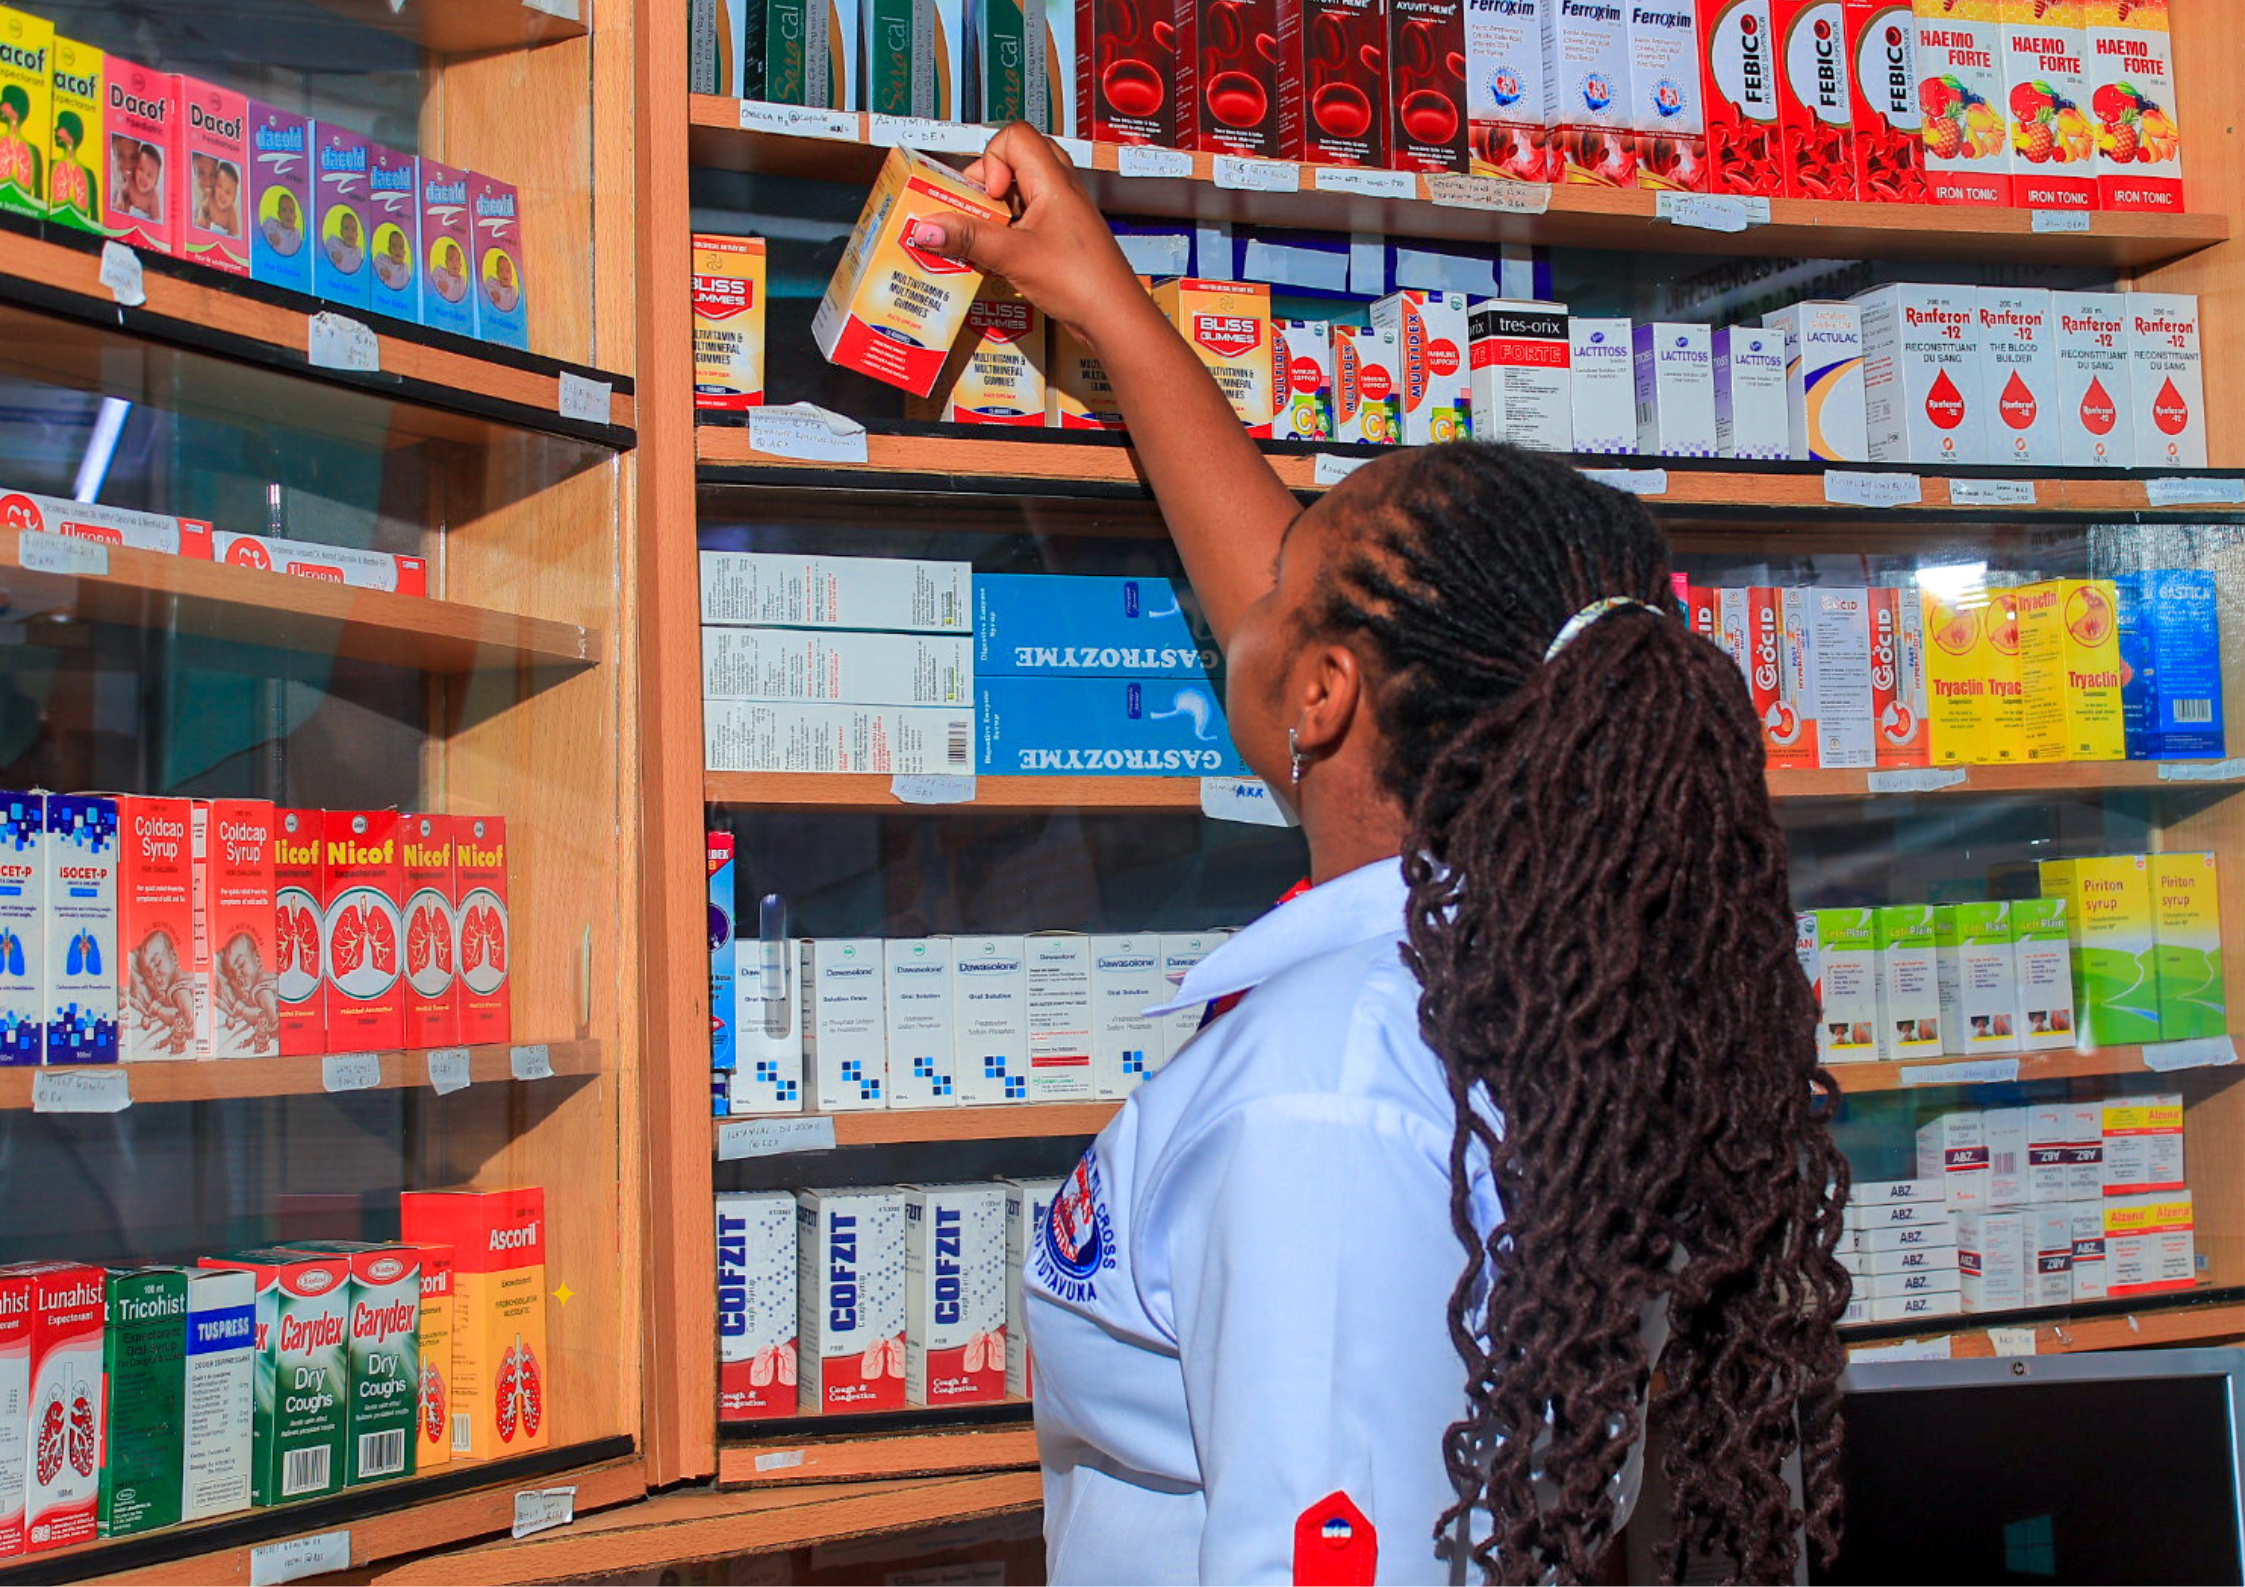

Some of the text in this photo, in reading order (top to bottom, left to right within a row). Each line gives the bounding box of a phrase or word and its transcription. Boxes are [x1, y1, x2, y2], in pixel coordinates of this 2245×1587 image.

[1469, 0, 1534, 16] Ferroxim
[1561, 0, 1621, 22] Ferroxim
[1632, 7, 1692, 28] Ferroxim
[1920, 30, 1974, 49] HAEMO
[2012, 36, 2065, 55] HAEMO
[2096, 38, 2148, 57] HAEMO
[1740, 14, 1763, 103] FEBICO
[1813, 18, 1837, 107] FEBICO
[1948, 50, 1991, 68] FORTE
[2039, 55, 2081, 74] FORTE
[2124, 57, 2164, 76] FORTE
[1885, 25, 1908, 113] FEBICO
[110, 84, 165, 122] Dacof
[190, 103, 242, 140] Dacof
[256, 125, 303, 150] dacold
[321, 146, 367, 170] dacold
[370, 166, 412, 189] dacold
[426, 181, 466, 204] dacold
[1936, 187, 1998, 201] IRON TONIC
[2028, 190, 2088, 204] IRON TONIC
[2114, 190, 2173, 204] IRON TONIC
[477, 194, 515, 216] dacold
[891, 270, 950, 302] MULTIVITAMIN &
[888, 283, 942, 312] MULTIMINERAL
[893, 297, 929, 319] GUMMIES
[971, 303, 1027, 318] BLISS
[1906, 307, 1971, 327] Ranferon
[970, 318, 1027, 330] GUMMIES
[1200, 317, 1254, 332] BLISS
[1500, 318, 1560, 334] tres-orix
[1980, 309, 2042, 328] Ranferon
[2061, 316, 2121, 334] Ranferon
[2135, 317, 2193, 335] Ranferon
[1200, 332, 1255, 344] GUMMIES
[1806, 332, 1858, 343] LACTULAC
[1941, 326, 1961, 339] -12
[2014, 327, 2032, 340] -12
[2095, 334, 2112, 347] -12
[2167, 335, 2185, 347] -12
[1408, 314, 1422, 398] MULTIDEX
[1427, 350, 1456, 358] IMMUNE
[1500, 345, 1562, 363] FORTE
[1574, 346, 1628, 357] LACTITOSS
[1661, 350, 1708, 363] LACTITOSS
[1905, 343, 1976, 352] RECONSTITUANT
[1989, 343, 2038, 352] THE BLOOD
[2061, 350, 2127, 360] RECONSTITUANT
[2134, 351, 2199, 361] RECONSTITUANT
[695, 353, 731, 366] GUMMIES
[973, 352, 1020, 365] MULTIVITAMIN
[1429, 358, 1459, 366] SUPPORT
[1735, 354, 1781, 367] LACTITOSS
[1923, 354, 1962, 363] DU SANG
[1996, 354, 2032, 363] BUILDER
[2077, 362, 2114, 371] DU SANG
[2150, 362, 2186, 371] DU SANG
[974, 363, 1024, 376] MULTIMINERAL
[1274, 337, 1286, 406] MULTIDEX
[1343, 344, 1355, 413] MULTIDEX
[983, 375, 1015, 387] GUMMIES
[1929, 400, 1962, 409] Ranferon
[2002, 401, 2034, 409] Ranferon
[2082, 406, 2114, 414] Ranferon
[1296, 409, 1312, 432] C
[1365, 416, 1381, 438] C
[1434, 420, 1450, 443] C
[2018, 590, 2057, 611] Tryactin
[980, 619, 988, 661] Digestive
[1015, 647, 1218, 670] GASTROZYME
[1933, 678, 1983, 698] Tryactin
[2069, 671, 2118, 690] Tryactin
[1018, 749, 1222, 770] GASTROZYME
[135, 816, 184, 843] Coldcap
[219, 822, 266, 846] Coldcap
[141, 838, 179, 865] Syrup
[226, 844, 260, 869] Syrup
[328, 839, 394, 865] Nicof
[404, 843, 450, 867] Nicof
[458, 844, 503, 867] Nicof
[59, 867, 107, 879] ISOCET-P
[2161, 875, 2195, 888] Piriton
[2084, 879, 2124, 892] Piriton
[2085, 899, 2117, 913] syrup
[2162, 896, 2190, 909] syrup
[826, 967, 874, 977] Dawasolone
[897, 966, 943, 976] Dawasolone
[958, 961, 1018, 973] Dawasolone
[1098, 958, 1155, 969] Dawasolone
[2147, 1109, 2180, 1120] Alzena
[1953, 1151, 1973, 1163] ABZ
[2041, 1151, 2061, 1162] ABZ
[2076, 1150, 2096, 1161] ABZ
[1890, 1185, 1912, 1197] ABZ
[1891, 1208, 1913, 1220] ABZ
[2110, 1211, 2144, 1222] Alzena
[2156, 1207, 2190, 1218] Alzena
[489, 1222, 536, 1251] Ascoril
[1096, 1203, 1116, 1270] CROSS
[1900, 1231, 1921, 1243] ABZ
[934, 1206, 961, 1325] COFZIT
[1902, 1254, 1924, 1266] ABZ
[2046, 1258, 2065, 1269] ABZ
[719, 1214, 746, 1337] COFZIT
[829, 1212, 857, 1332] COFZIT
[1035, 1249, 1097, 1301] TUTAVUKA
[1905, 1277, 1926, 1289] ABZ
[38, 1284, 103, 1311] Lunahist
[1905, 1300, 1926, 1311] ABZ
[119, 1293, 186, 1321] Tricohist
[960, 1295, 969, 1321] Cough
[353, 1298, 415, 1344] Carydex
[746, 1305, 755, 1334] Cough
[197, 1317, 249, 1342] TUSPRESS
[281, 1310, 344, 1357] Carydex
[368, 1352, 400, 1378] Dry
[295, 1366, 327, 1392] Dry
[933, 1378, 959, 1387] Cough
[360, 1378, 406, 1399] Coughs
[719, 1392, 746, 1400] Cough
[829, 1391, 877, 1402] Congestion
[933, 1385, 978, 1395] Congestion
[285, 1392, 333, 1414] Coughs
[719, 1398, 766, 1409] Congestion
